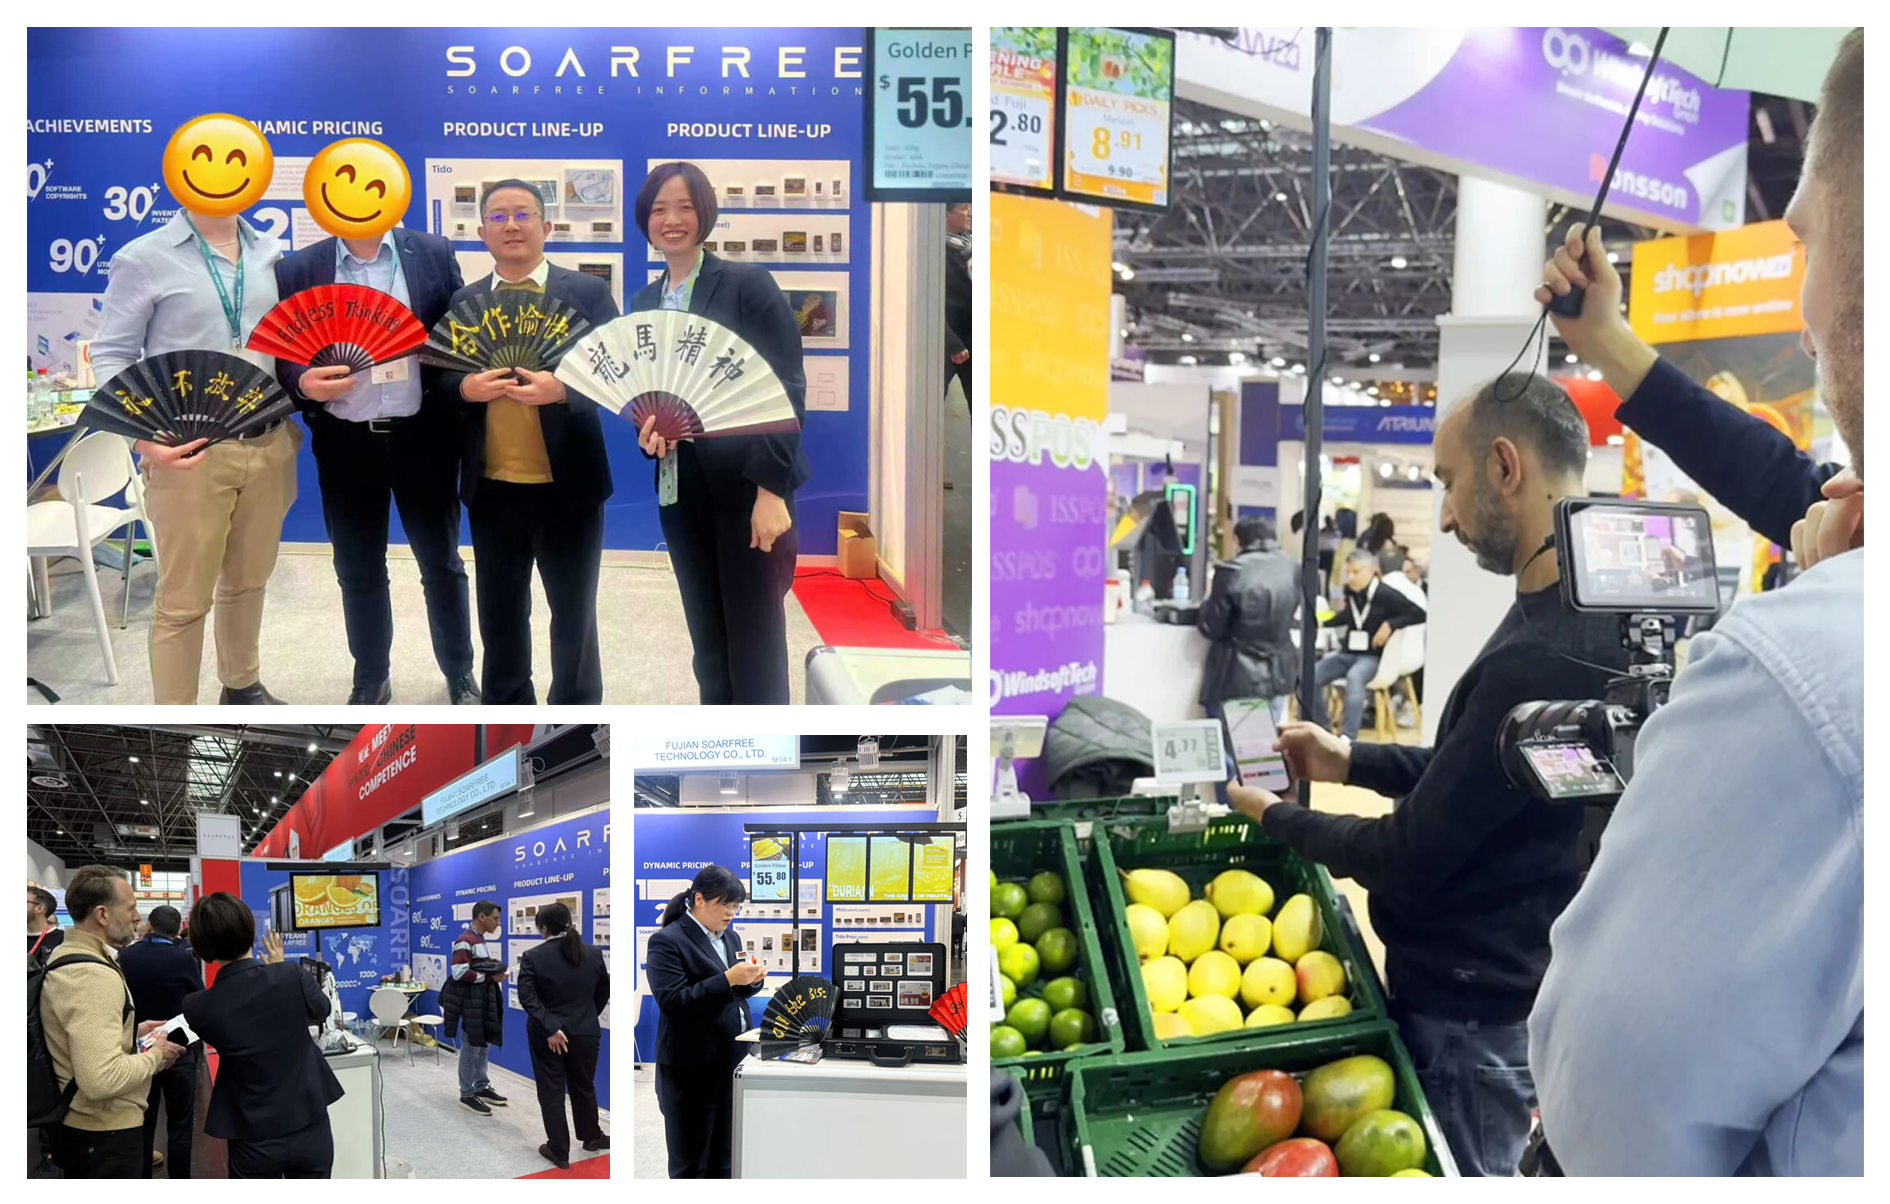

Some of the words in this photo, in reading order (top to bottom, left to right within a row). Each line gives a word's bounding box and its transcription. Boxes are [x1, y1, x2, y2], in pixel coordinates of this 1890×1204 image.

[888, 42, 957, 59] Golden
[446, 46, 862, 78] SOARFREE
[879, 73, 891, 90] $
[447, 84, 606, 95] SOARFREE
[637, 84, 862, 96] INFORMATION
[27, 118, 153, 134] ACHIEVEMENTS
[311, 121, 384, 136] PRICING
[443, 122, 527, 137] PRODUCT
[531, 122, 604, 137] LINE-UP
[667, 122, 752, 138] PRODUCT
[757, 123, 831, 138] LINE-UP
[432, 164, 453, 174] Tido
[45, 185, 82, 193] SOFTWARE
[45, 193, 88, 201] COPYRIGHTS
[276, 302, 335, 344] Endless
[449, 303, 571, 356] 合作愉快
[587, 323, 745, 391] 龍馬精神
[1003, 661, 1096, 698] WindsoftTech
[665, 741, 698, 751] FUJIAN
[701, 739, 754, 748] SOARFREE
[655, 751, 720, 761] TECHNOLOGY
[723, 750, 743, 760] CO.,
[746, 749, 766, 758] LTD.
[359, 745, 416, 800] COMPETENCE
[514, 877, 543, 889] PRODUCT
[544, 873, 574, 885] LINE-UP
[298, 917, 335, 925] ORANGES
